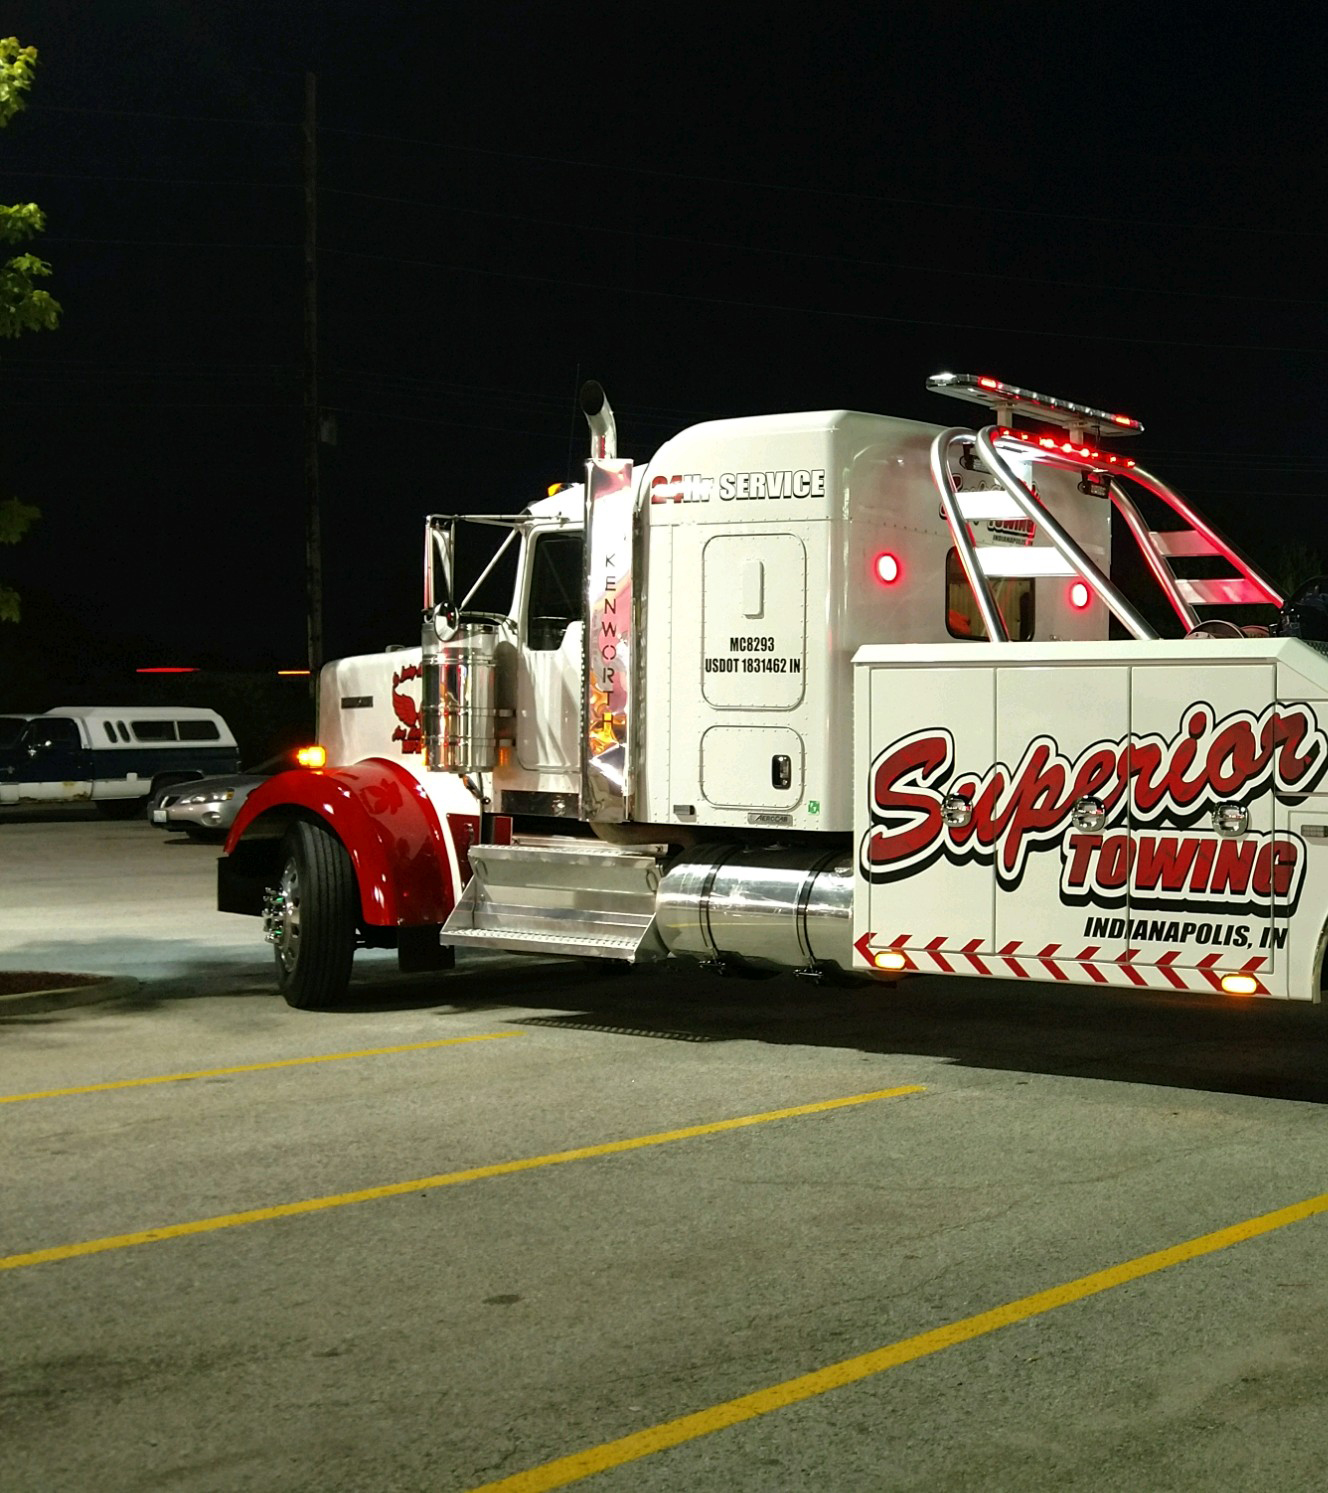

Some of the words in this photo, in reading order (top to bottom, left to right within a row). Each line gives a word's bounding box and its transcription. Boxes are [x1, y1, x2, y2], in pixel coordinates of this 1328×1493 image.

[719, 469, 825, 501] SERVICE
[601, 553, 617, 732] KENWORTH
[730, 636, 775, 652] MC8293
[705, 658, 740, 673] USDOT
[742, 658, 787, 673] 1831462
[789, 658, 801, 673] IN
[1061, 830, 1307, 916] TOWING
[1083, 916, 1253, 950] INDIANAPOLIS,
[1258, 926, 1289, 949] IN
